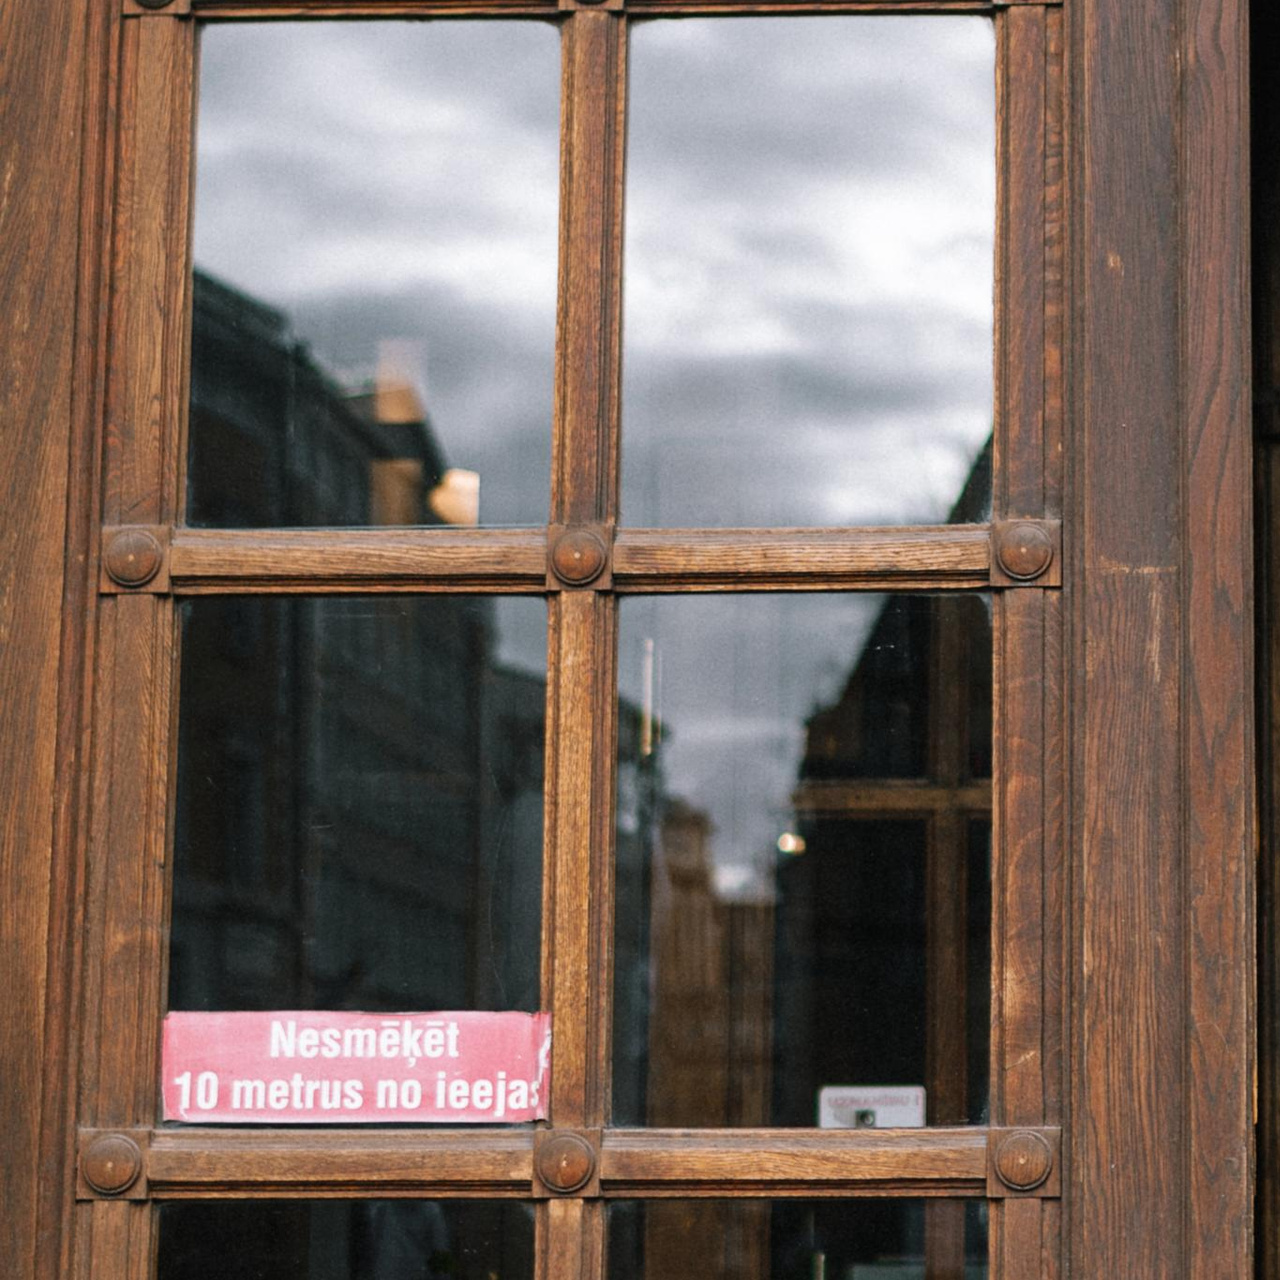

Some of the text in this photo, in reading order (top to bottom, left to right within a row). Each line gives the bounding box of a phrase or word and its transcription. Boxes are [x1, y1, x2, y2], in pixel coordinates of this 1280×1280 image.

[270, 1020, 460, 1067] Nesmēķēt
[173, 1071, 540, 1117] 10 metrus no ieejas
